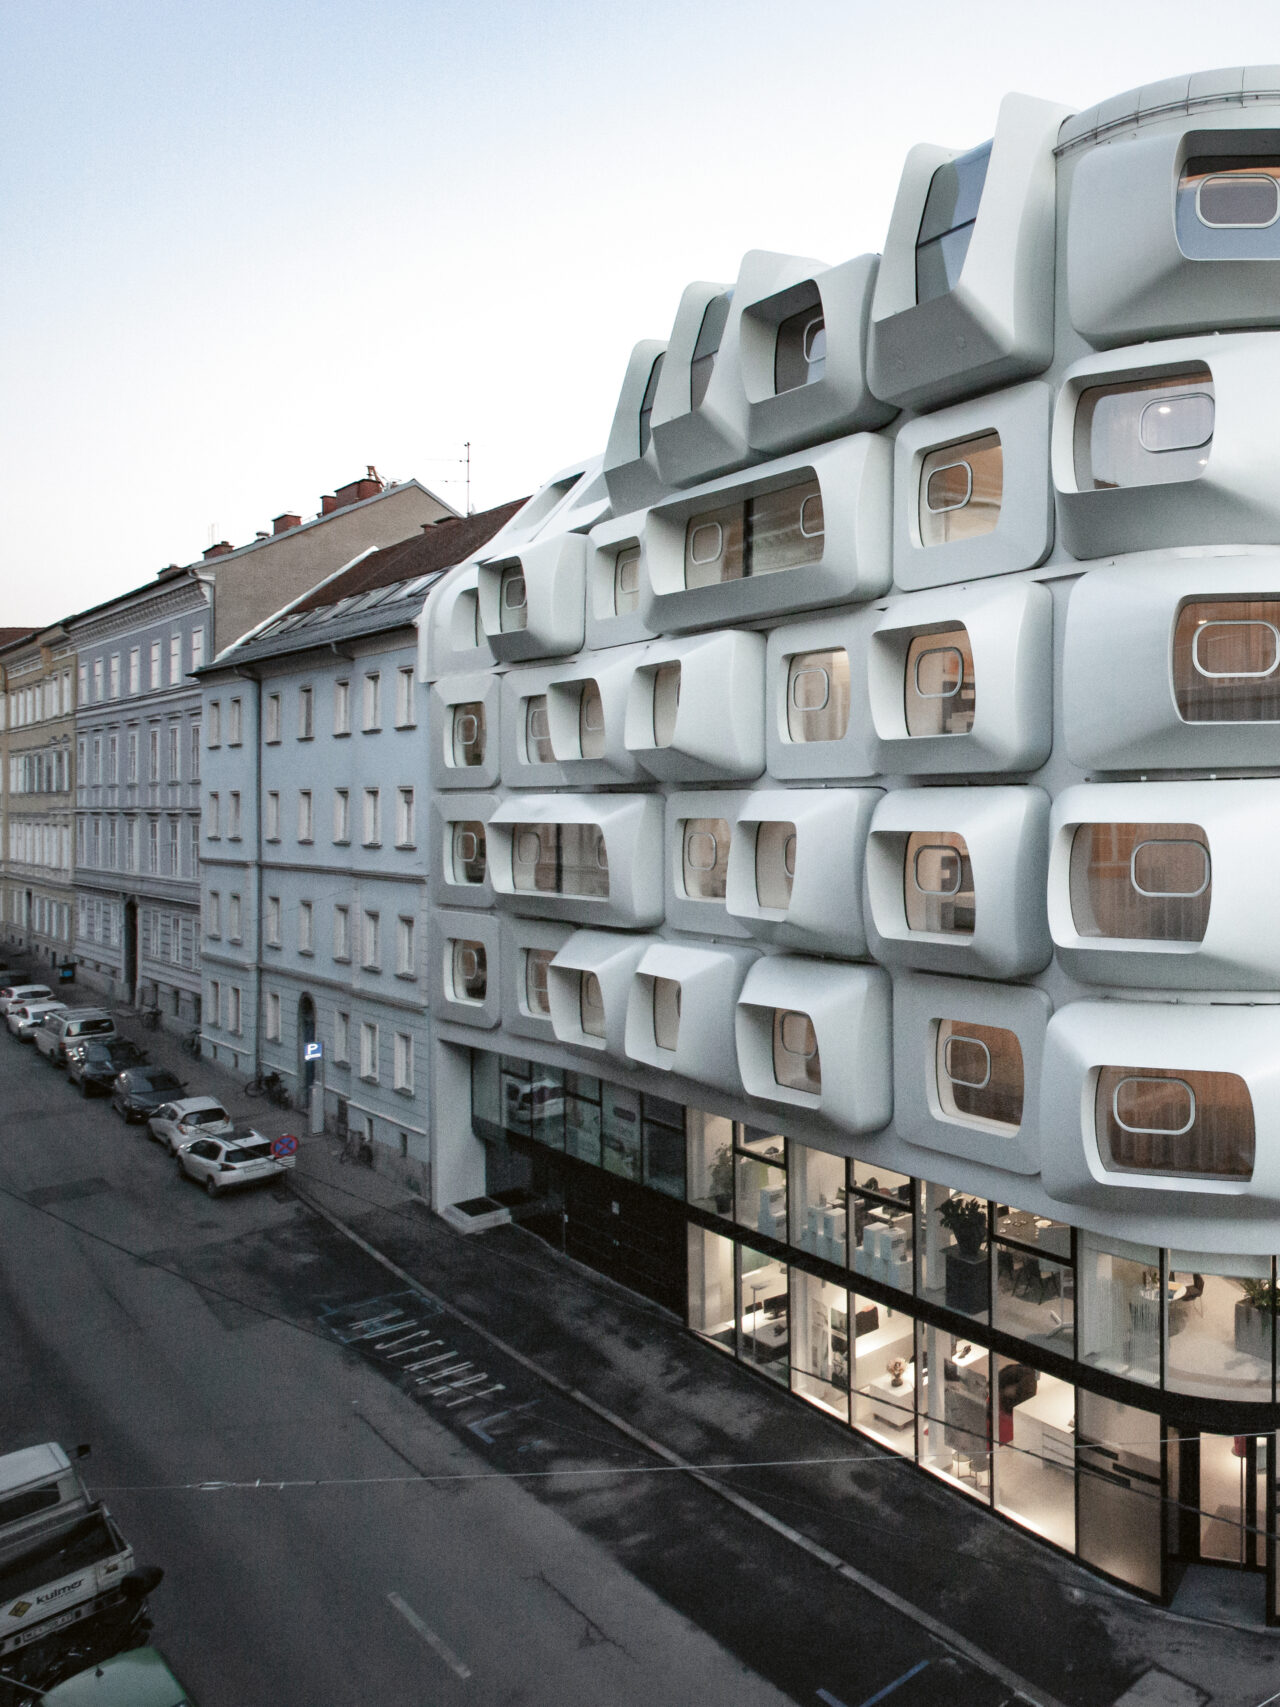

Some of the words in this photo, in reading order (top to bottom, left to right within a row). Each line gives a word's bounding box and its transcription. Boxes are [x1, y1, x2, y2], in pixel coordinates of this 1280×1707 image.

[307, 1043, 318, 1055] P
[348, 1308, 506, 1407] AUSFAHRT
[36, 1578, 85, 1604] kulmer
